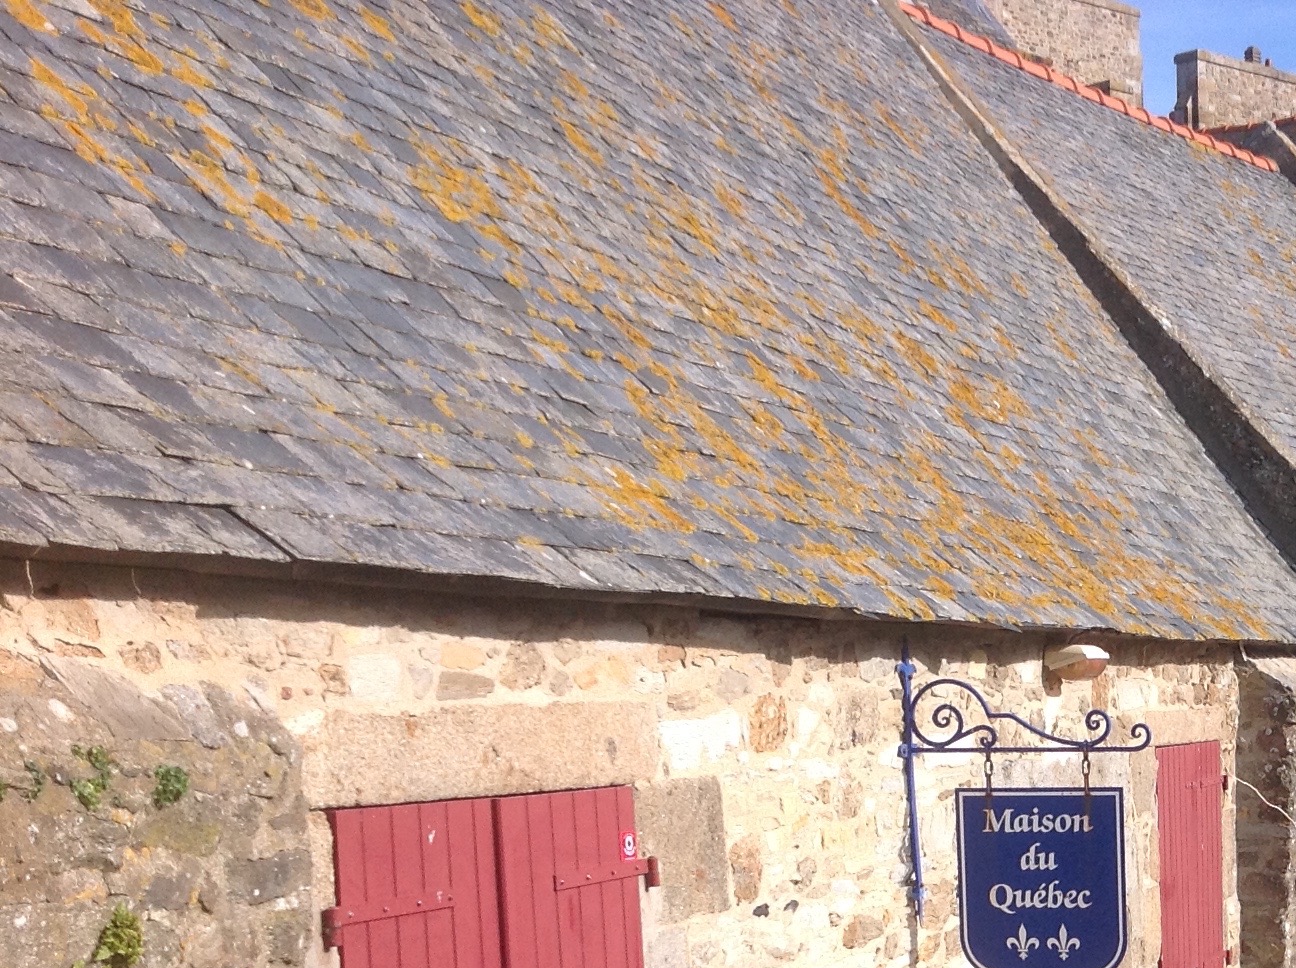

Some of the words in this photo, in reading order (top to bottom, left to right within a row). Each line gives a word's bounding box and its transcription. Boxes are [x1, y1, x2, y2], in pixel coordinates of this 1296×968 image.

[982, 807, 1093, 833] Maison
[1020, 842, 1058, 871] du
[989, 880, 1092, 914] Québec
